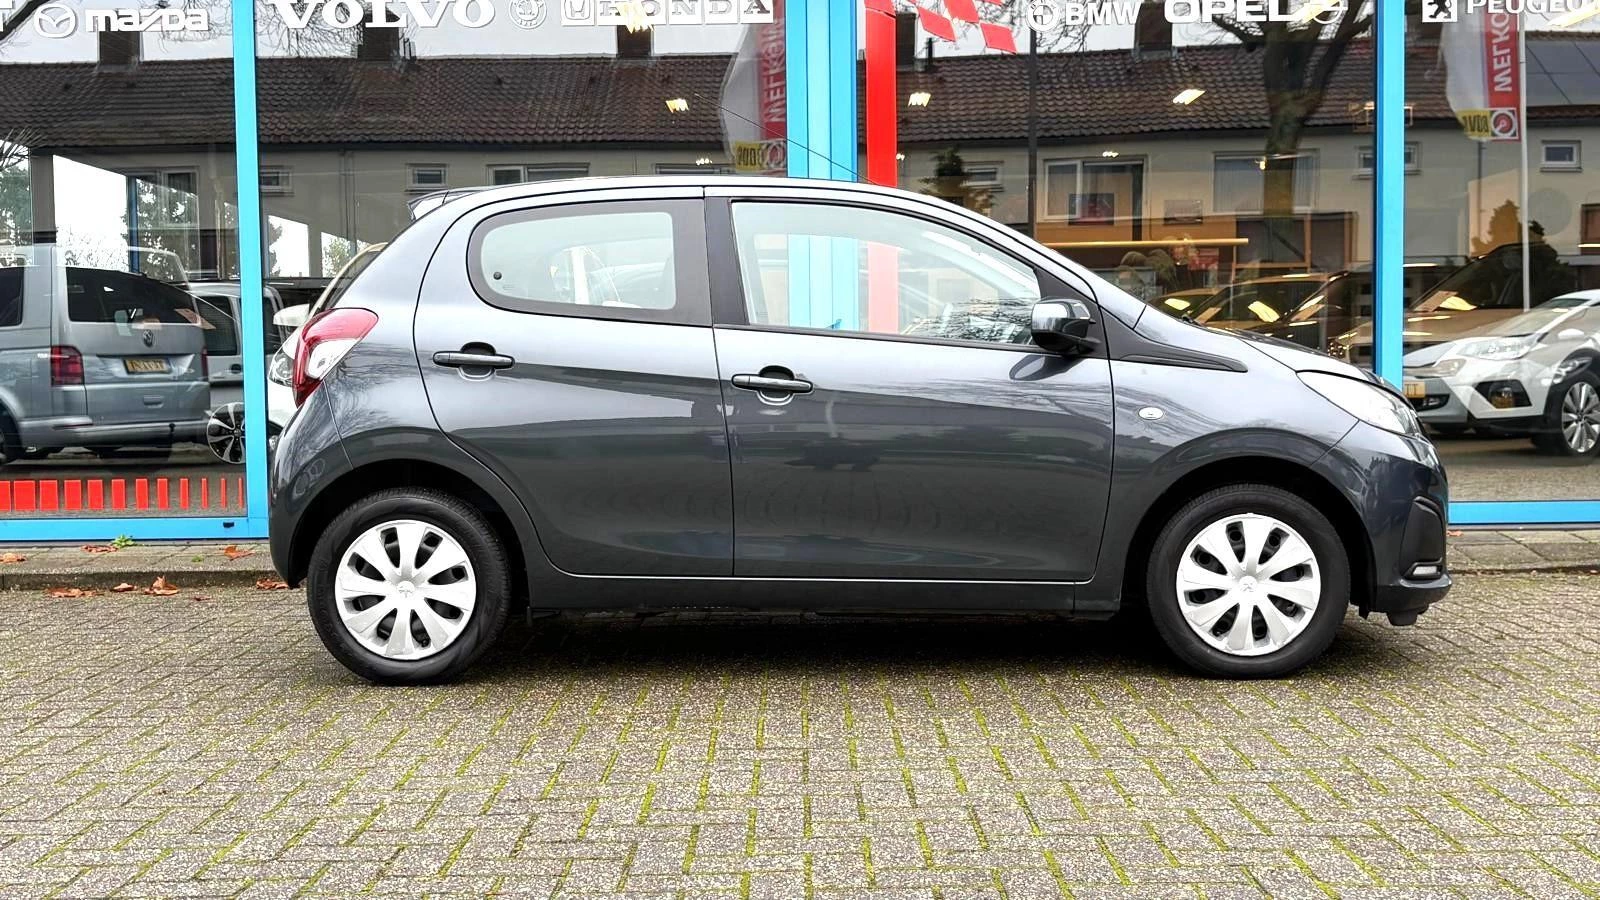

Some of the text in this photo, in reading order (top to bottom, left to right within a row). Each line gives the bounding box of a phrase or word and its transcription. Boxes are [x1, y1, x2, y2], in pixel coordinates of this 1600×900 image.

[271, 0, 495, 28] VOLVO
[598, 0, 771, 17] HONDA
[1064, 2, 1142, 25] BMW
[1165, 0, 1299, 23] OPEL
[1467, 0, 1600, 14] PEUGEO
